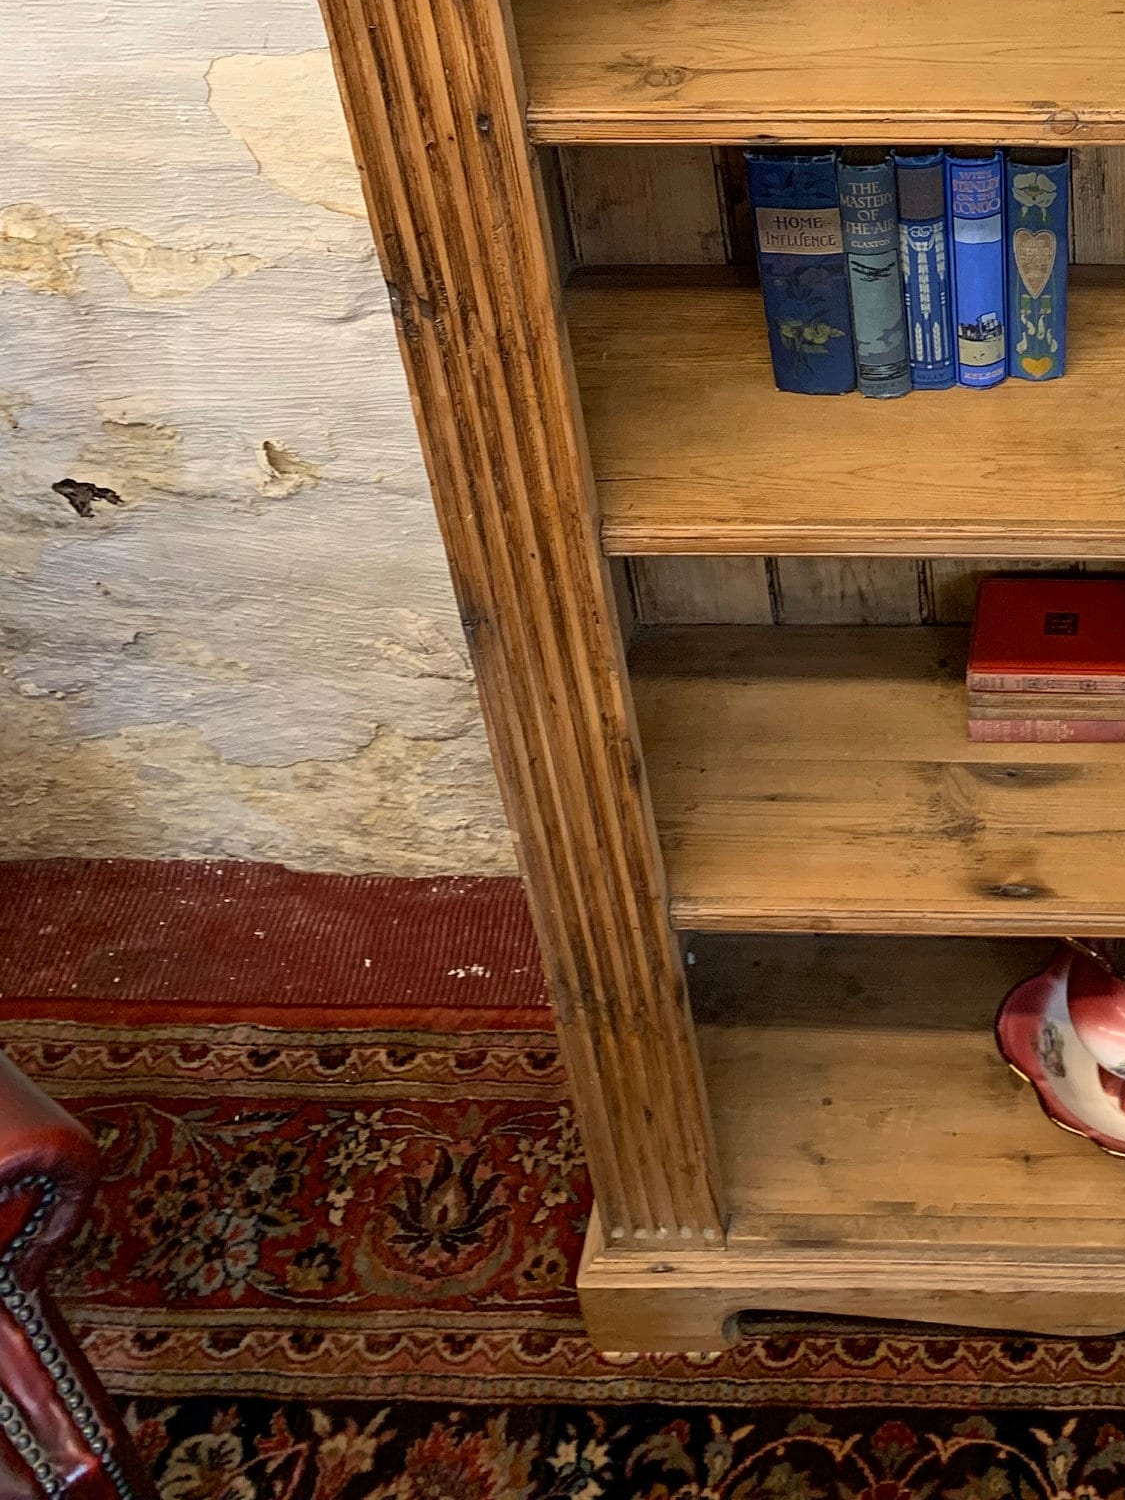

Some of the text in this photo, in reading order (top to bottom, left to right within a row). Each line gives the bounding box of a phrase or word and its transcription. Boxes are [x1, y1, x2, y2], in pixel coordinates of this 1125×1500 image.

[847, 181, 881, 195] THE
[840, 194, 894, 208] MASTERY
[953, 197, 1001, 215] CONGO
[857, 209, 880, 222] OF
[772, 216, 824, 232] HOME
[845, 221, 896, 235] THE AIR
[765, 230, 837, 248] INFLUENCE
[851, 238, 892, 249] CLAXTON
